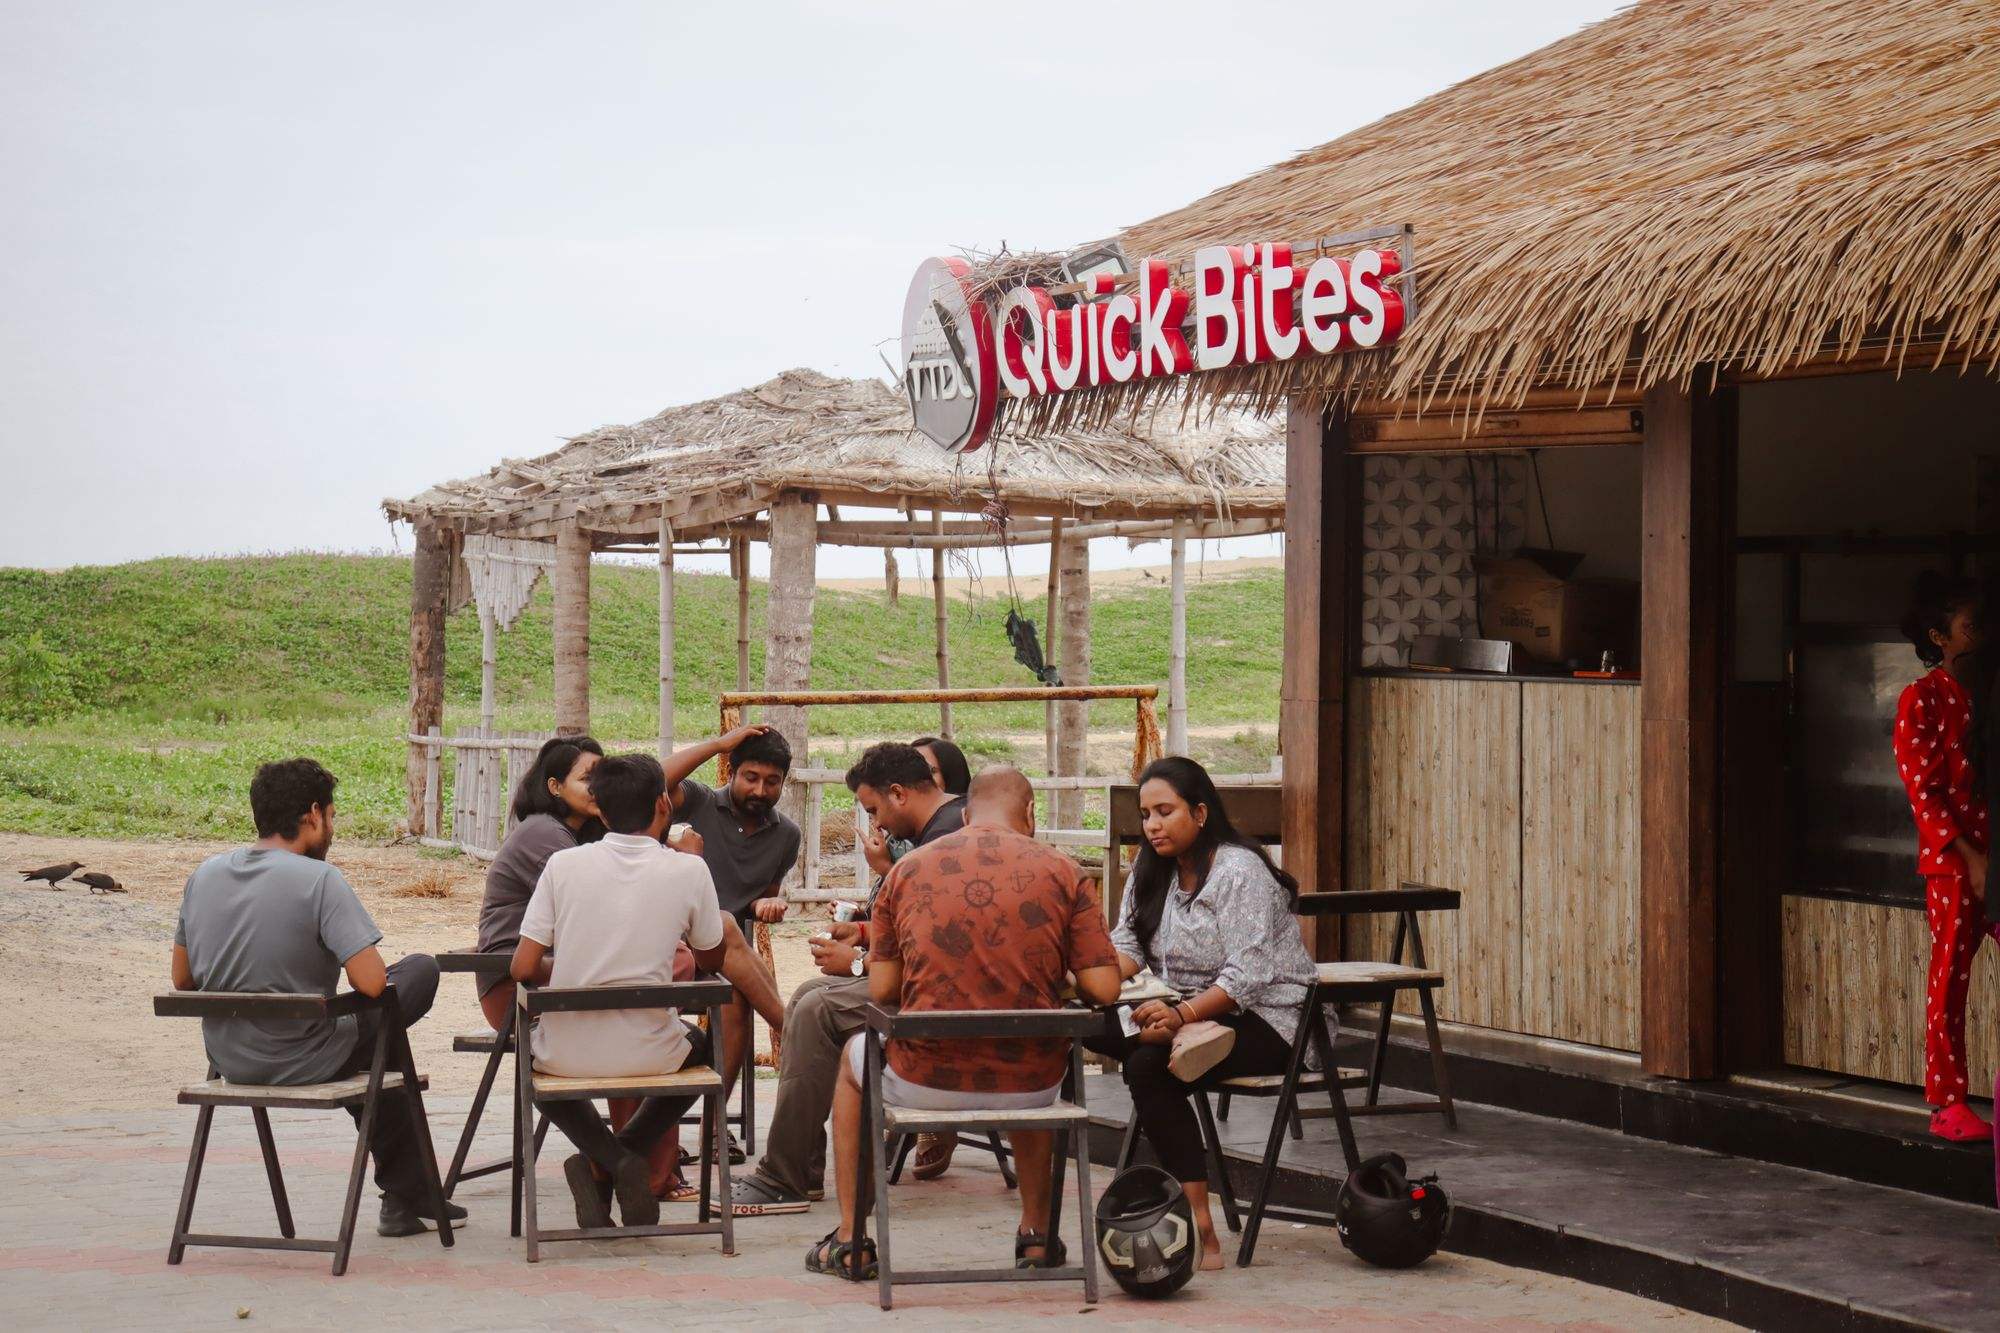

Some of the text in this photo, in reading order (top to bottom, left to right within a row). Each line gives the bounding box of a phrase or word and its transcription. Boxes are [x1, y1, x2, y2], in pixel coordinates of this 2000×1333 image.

[999, 242, 1385, 398] Quick Bites
[733, 1204, 764, 1214] rocs
